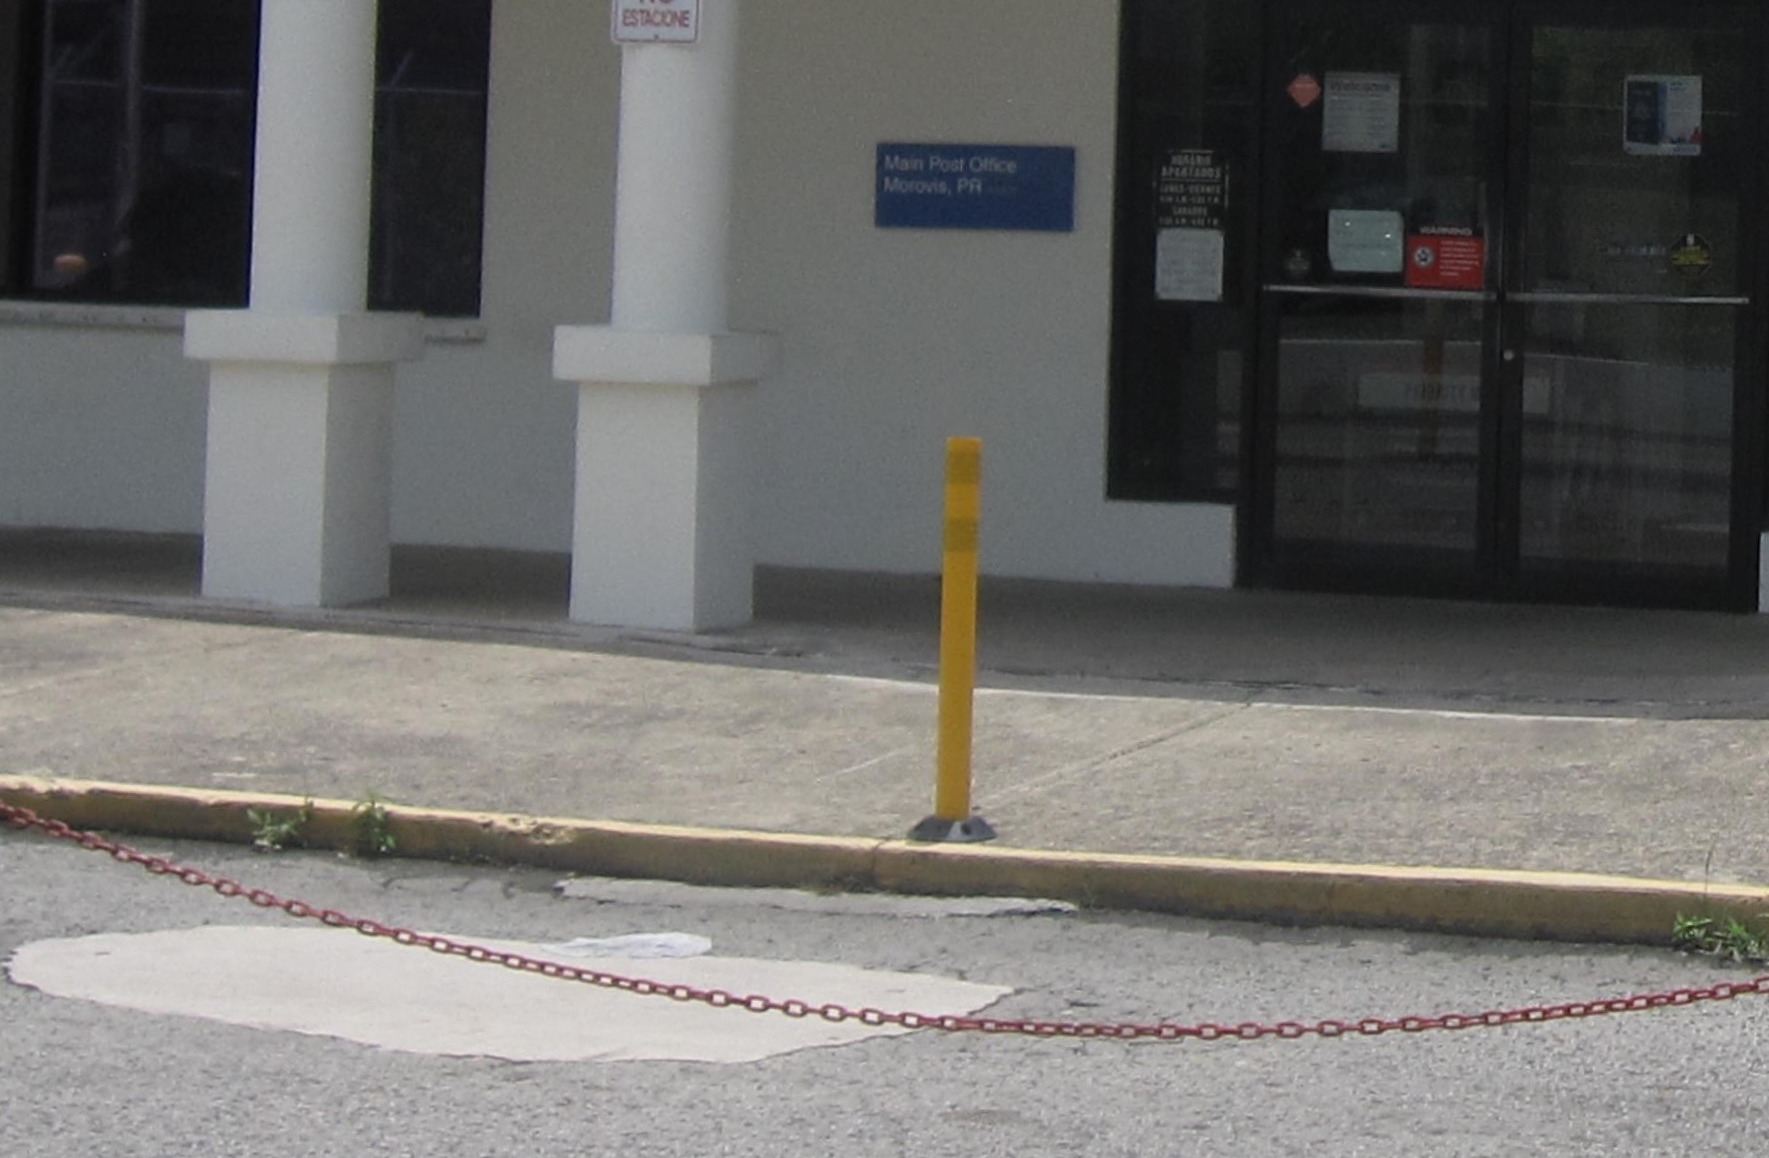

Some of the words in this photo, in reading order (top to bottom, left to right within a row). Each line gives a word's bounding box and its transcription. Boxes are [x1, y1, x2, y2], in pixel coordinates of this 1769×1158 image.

[622, 9, 690, 28] ESTACIONE
[884, 155, 924, 171] Main
[929, 155, 965, 172] Post
[969, 156, 1017, 173] Office
[883, 176, 952, 195] Morovis,
[957, 178, 983, 194] PR
